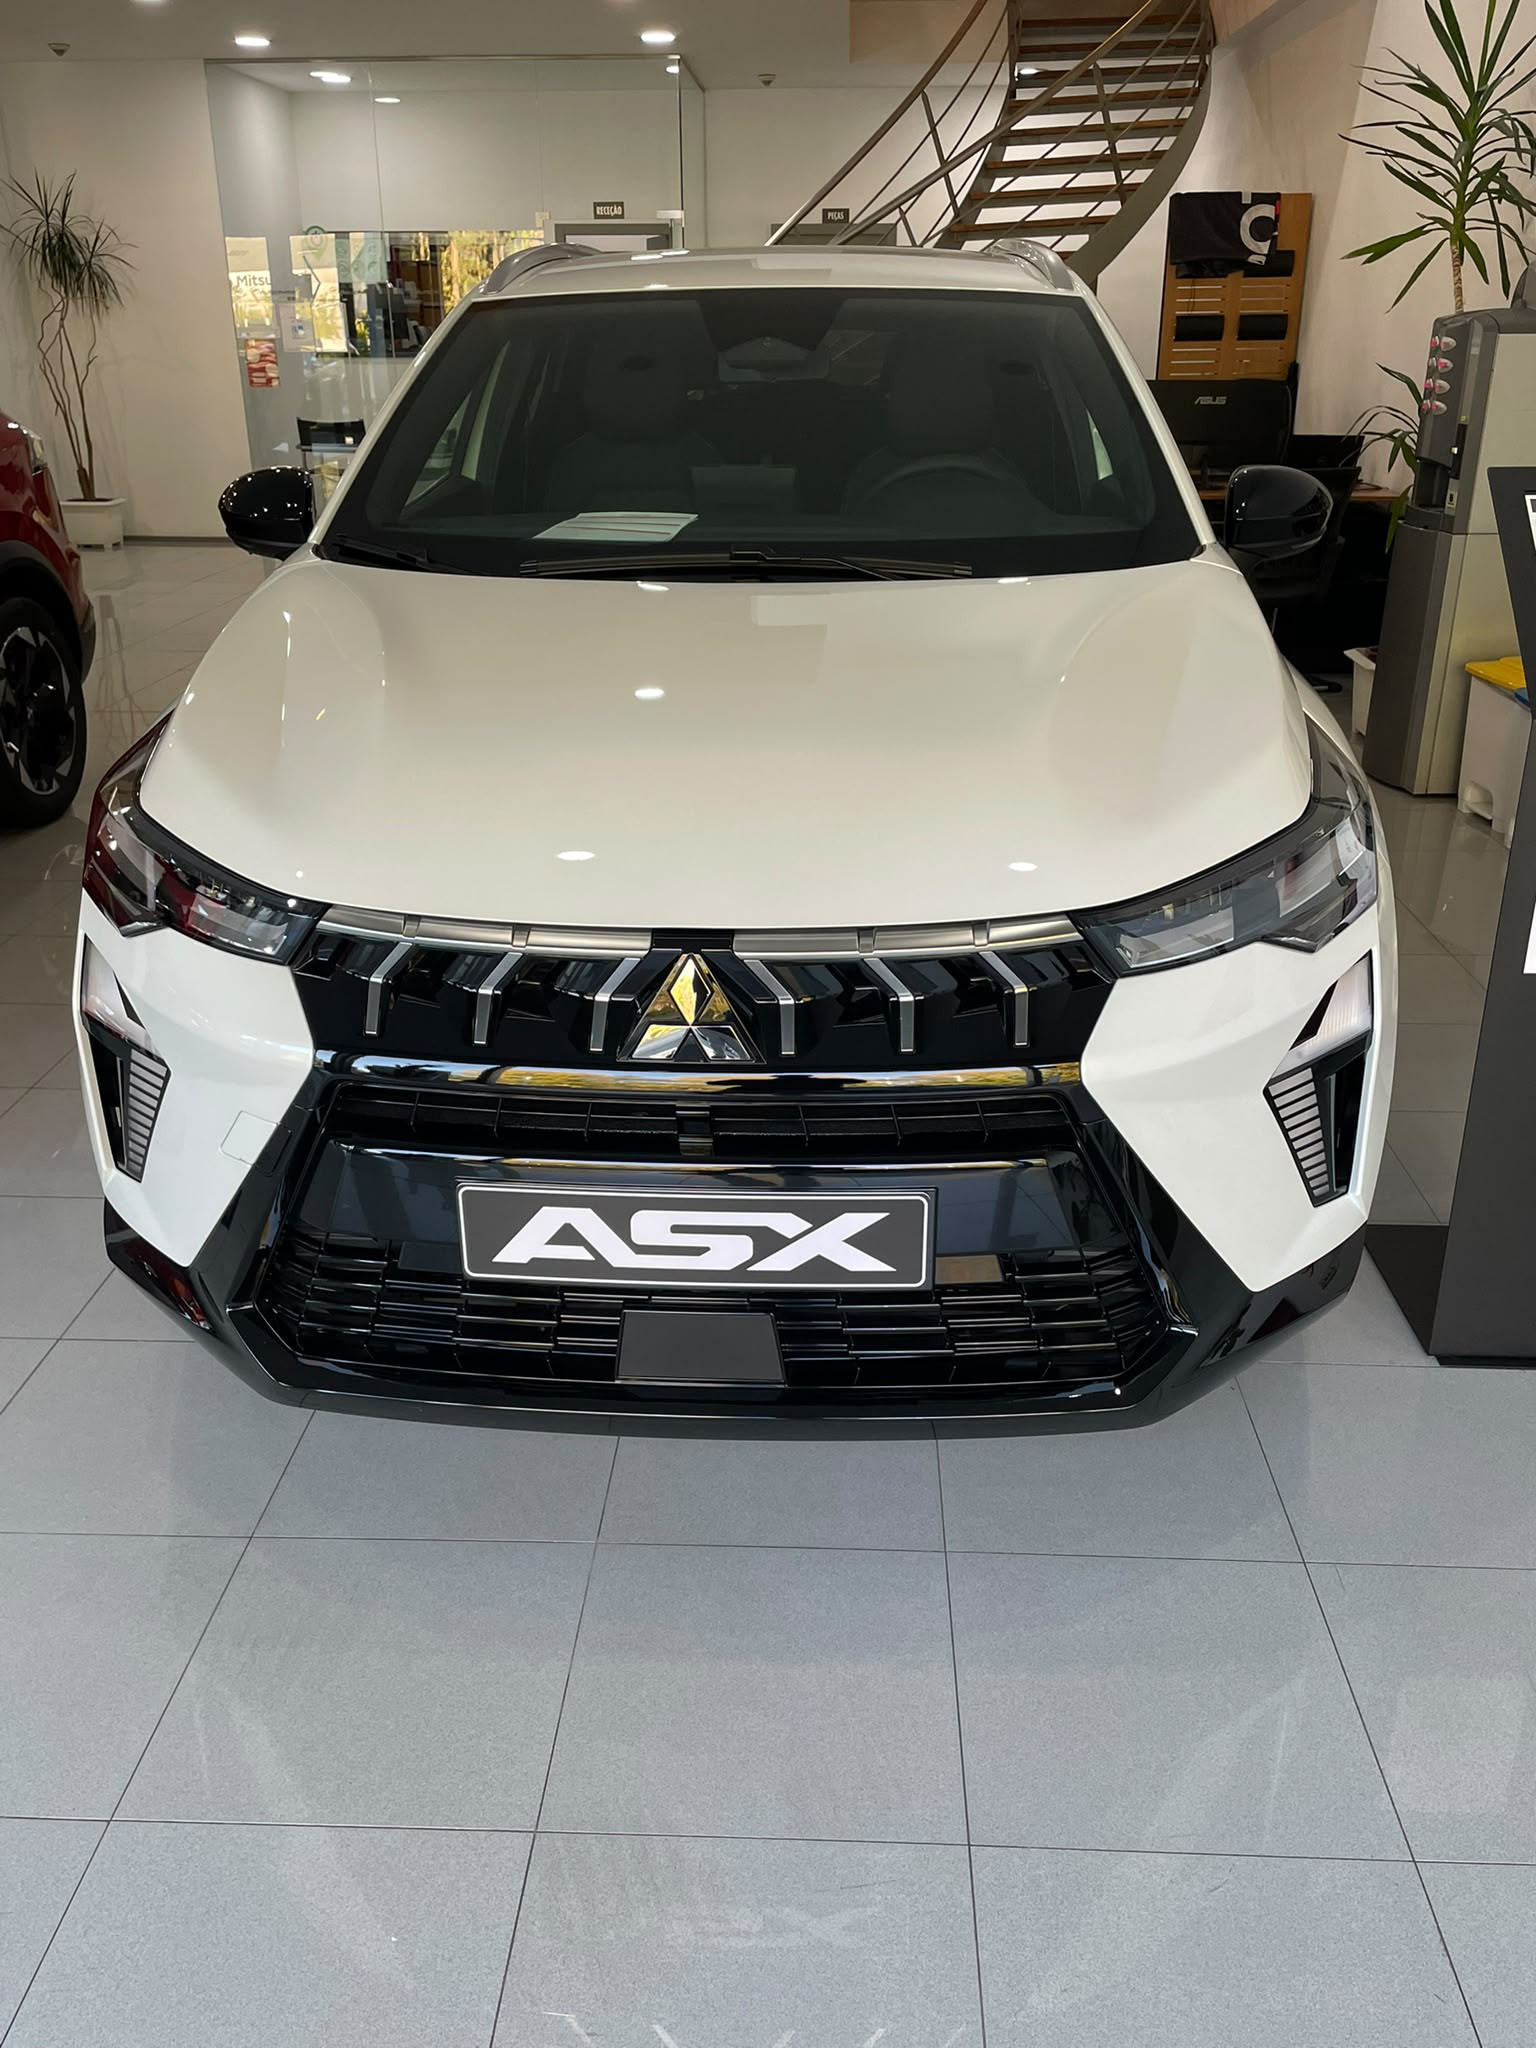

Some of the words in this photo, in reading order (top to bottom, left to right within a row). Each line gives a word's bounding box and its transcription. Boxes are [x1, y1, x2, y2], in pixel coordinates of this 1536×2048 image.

[596, 204, 623, 217] RECEÇÃO
[827, 211, 845, 221] PEÇAS
[1194, 396, 1227, 405] ASUS
[492, 1206, 897, 1272] ASX
